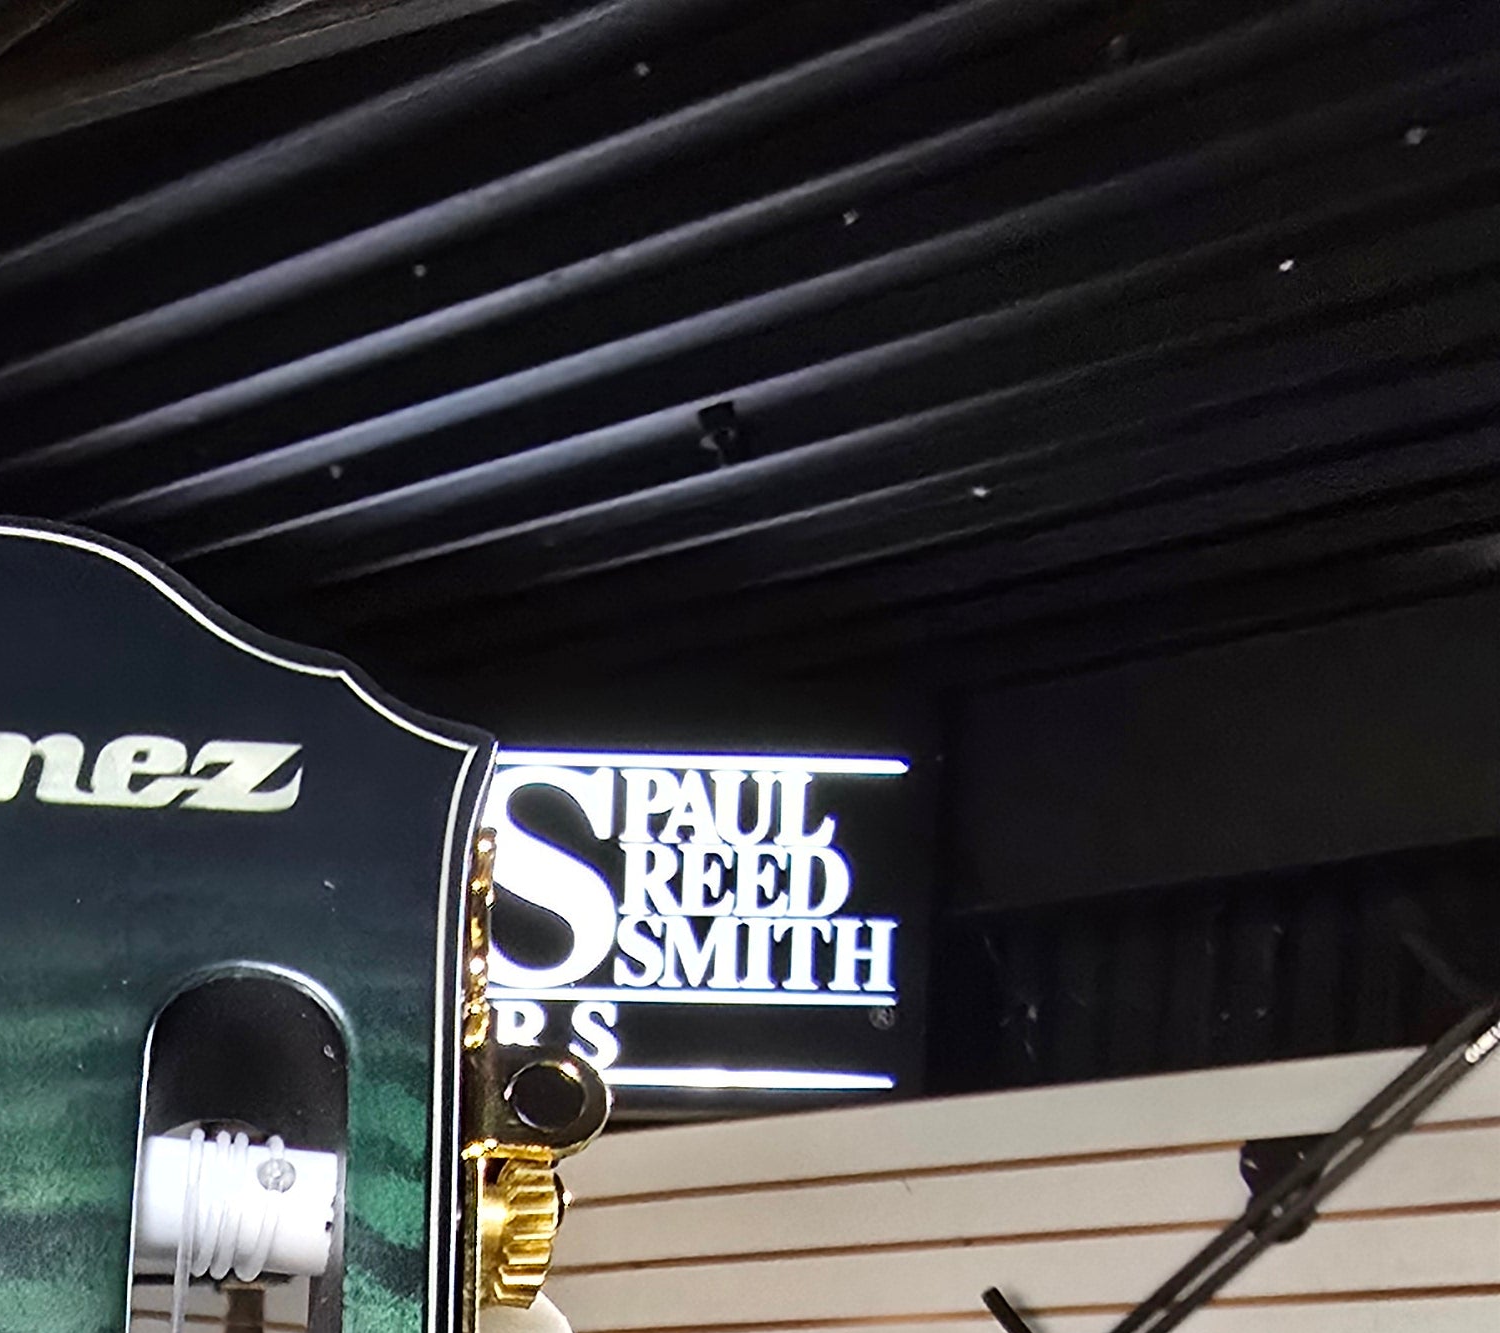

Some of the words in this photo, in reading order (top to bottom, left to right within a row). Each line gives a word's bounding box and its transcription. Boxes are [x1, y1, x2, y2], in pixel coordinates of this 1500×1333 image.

[618, 768, 836, 846] PAUL
[618, 842, 852, 918] REED
[614, 915, 899, 992] SMITH
